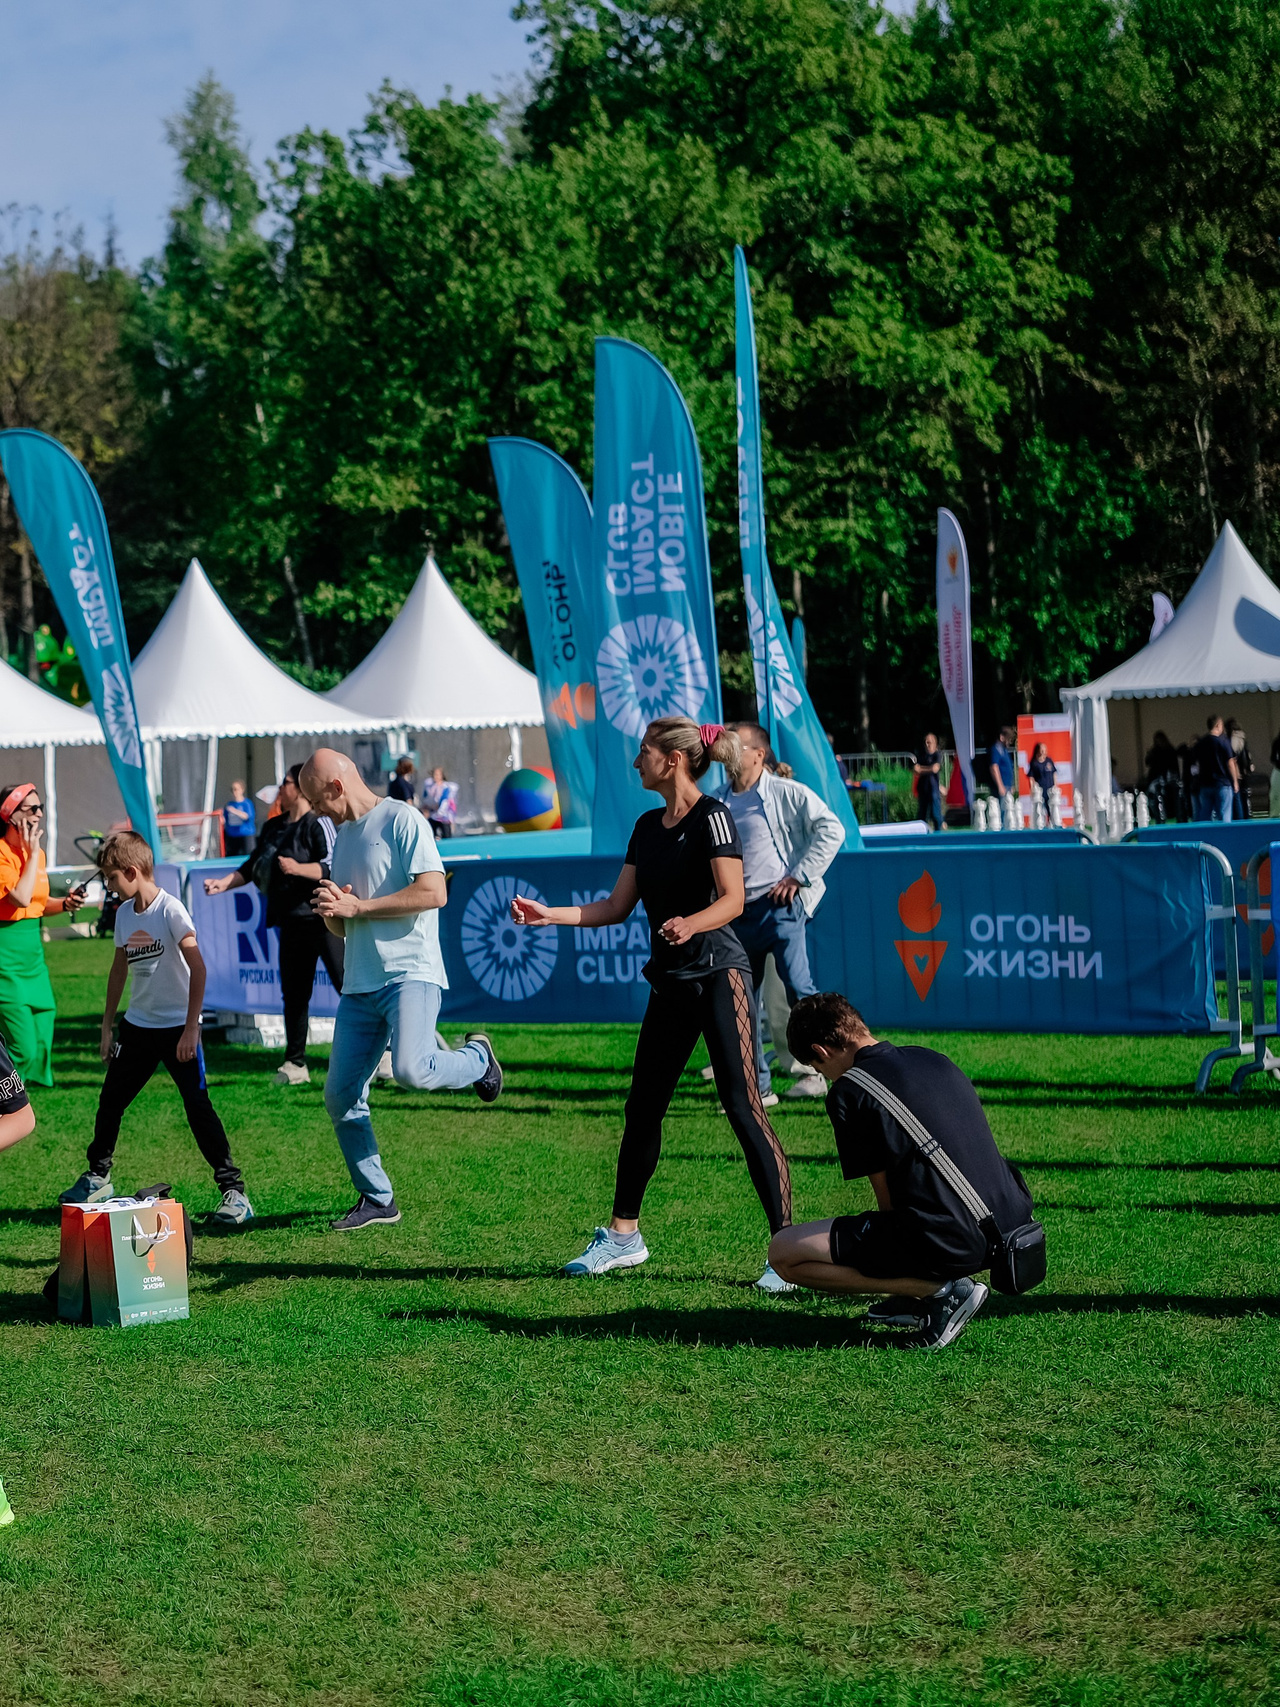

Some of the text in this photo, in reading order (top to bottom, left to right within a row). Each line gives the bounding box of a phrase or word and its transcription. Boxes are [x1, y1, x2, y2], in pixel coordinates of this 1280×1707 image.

[573, 922, 649, 951] IMPA
[970, 913, 1091, 943] ОГОНЬ
[963, 949, 1103, 980] ЖИЗНИ
[239, 968, 275, 984] РУССКАЯ
[142, 1282, 166, 1290] ЖИЗНИ
[143, 1276, 163, 1284] ОГОНЬ
